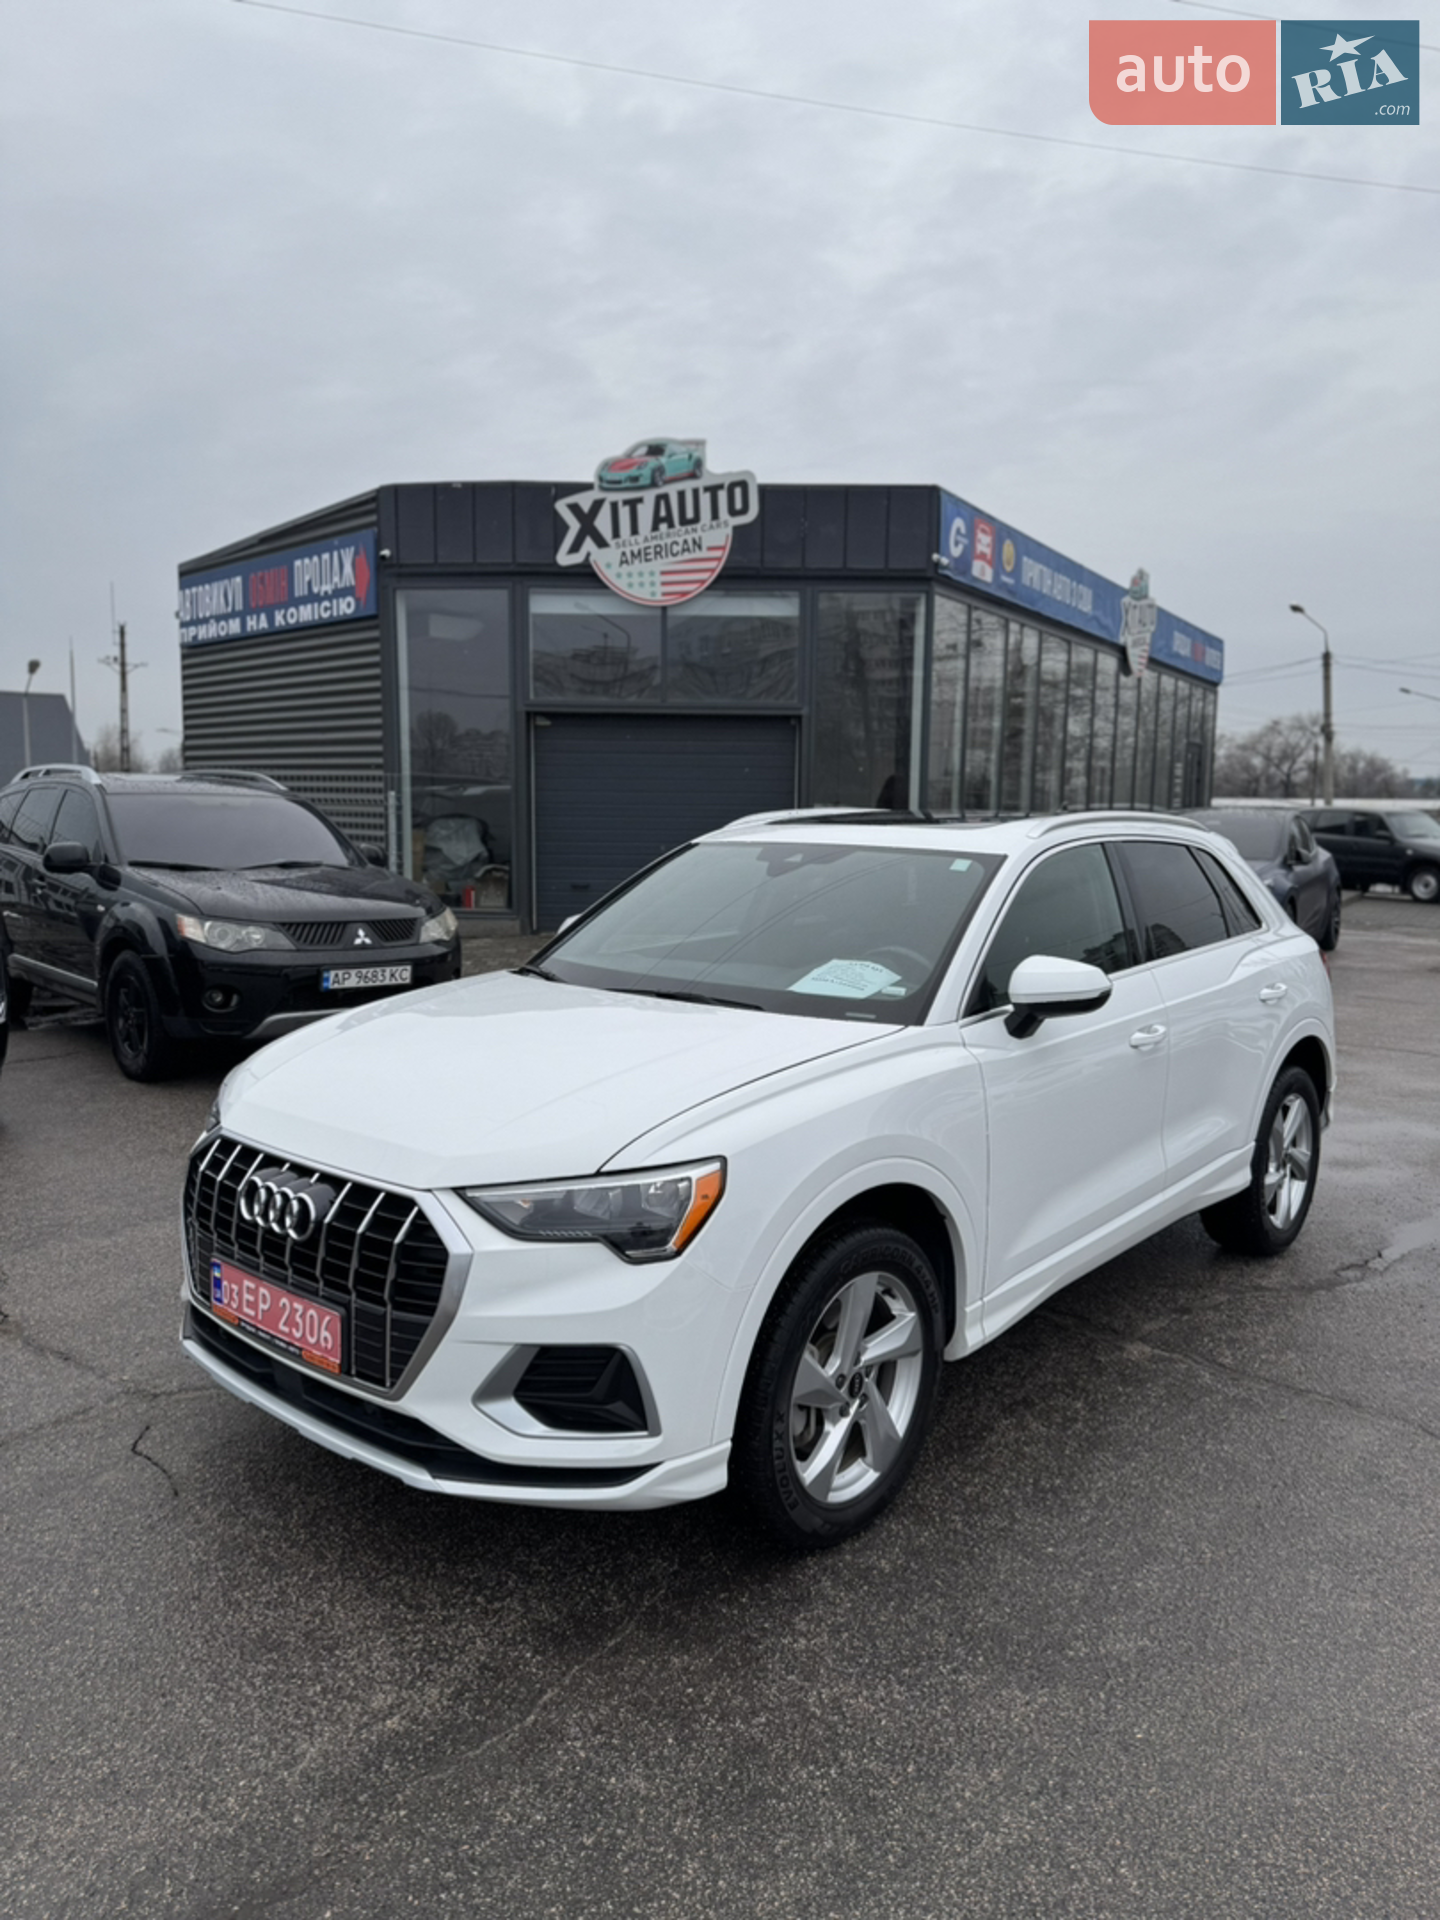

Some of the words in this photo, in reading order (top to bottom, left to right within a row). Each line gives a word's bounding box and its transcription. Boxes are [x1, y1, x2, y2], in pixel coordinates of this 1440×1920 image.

[614, 537, 640, 550] SELL
[642, 526, 698, 545] AMERICAN
[700, 519, 730, 533] CARS
[618, 536, 703, 568] AMERICAN
[293, 545, 356, 598] ПРОДАЖ
[180, 616, 241, 643] ПРИЙОМ
[246, 611, 269, 632] НА
[274, 596, 356, 628] КОМІСІЮ
[332, 971, 352, 986] AP
[354, 968, 387, 985] 9683
[388, 967, 409, 982] KC
[243, 1279, 271, 1320] EP
[278, 1297, 334, 1350] 2306
[774, 1411, 800, 1511] EVOLUXX
